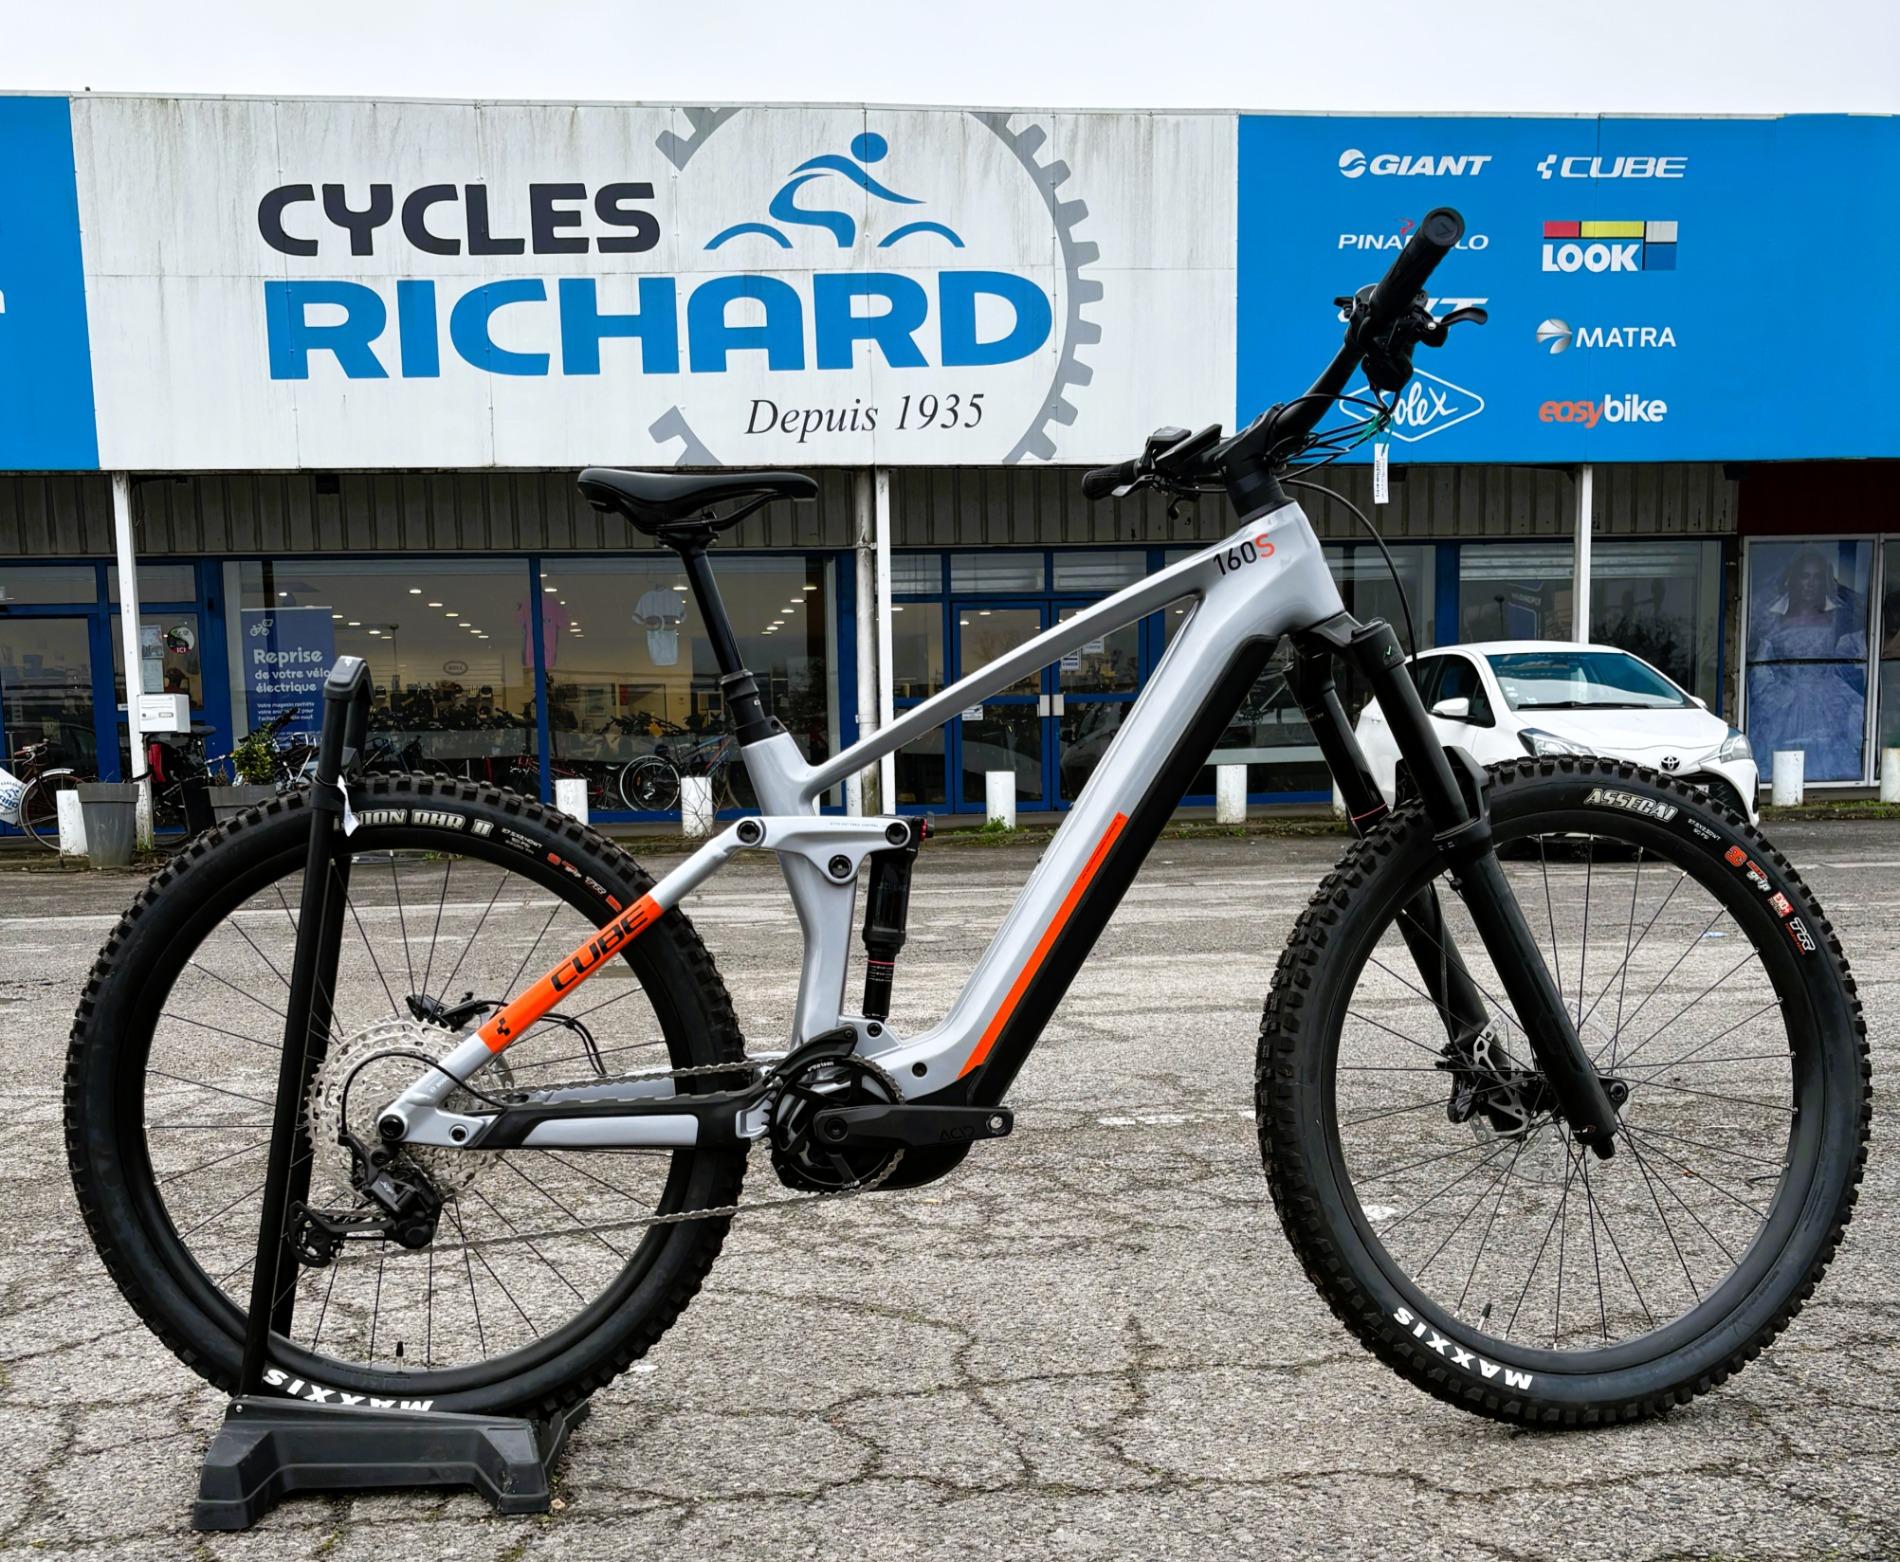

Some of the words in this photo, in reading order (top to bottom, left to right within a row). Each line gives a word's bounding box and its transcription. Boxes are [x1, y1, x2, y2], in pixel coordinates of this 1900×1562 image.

[1369, 154, 1493, 176] GIANT
[1560, 156, 1688, 178] CUBE
[257, 182, 661, 257] CYCLES
[1338, 234, 1489, 250] PINALO
[1542, 243, 1640, 273] LOOK
[264, 270, 1053, 380] RICHARD
[1575, 327, 1677, 348] MATRA
[744, 398, 879, 443] Depuis
[894, 393, 985, 431] 1935
[1538, 394, 1668, 429] easybike
[1213, 533, 1276, 576] 160S
[253, 646, 323, 668] Reprise
[254, 669, 270, 680] de
[272, 668, 304, 680] votre
[306, 667, 331, 679] vélo
[255, 681, 317, 695] électrique
[412, 809, 466, 831] DHR
[1583, 788, 1678, 822] ASSEGAI
[551, 905, 648, 992] CUBE
[1393, 1307, 1533, 1390] MAXXIS
